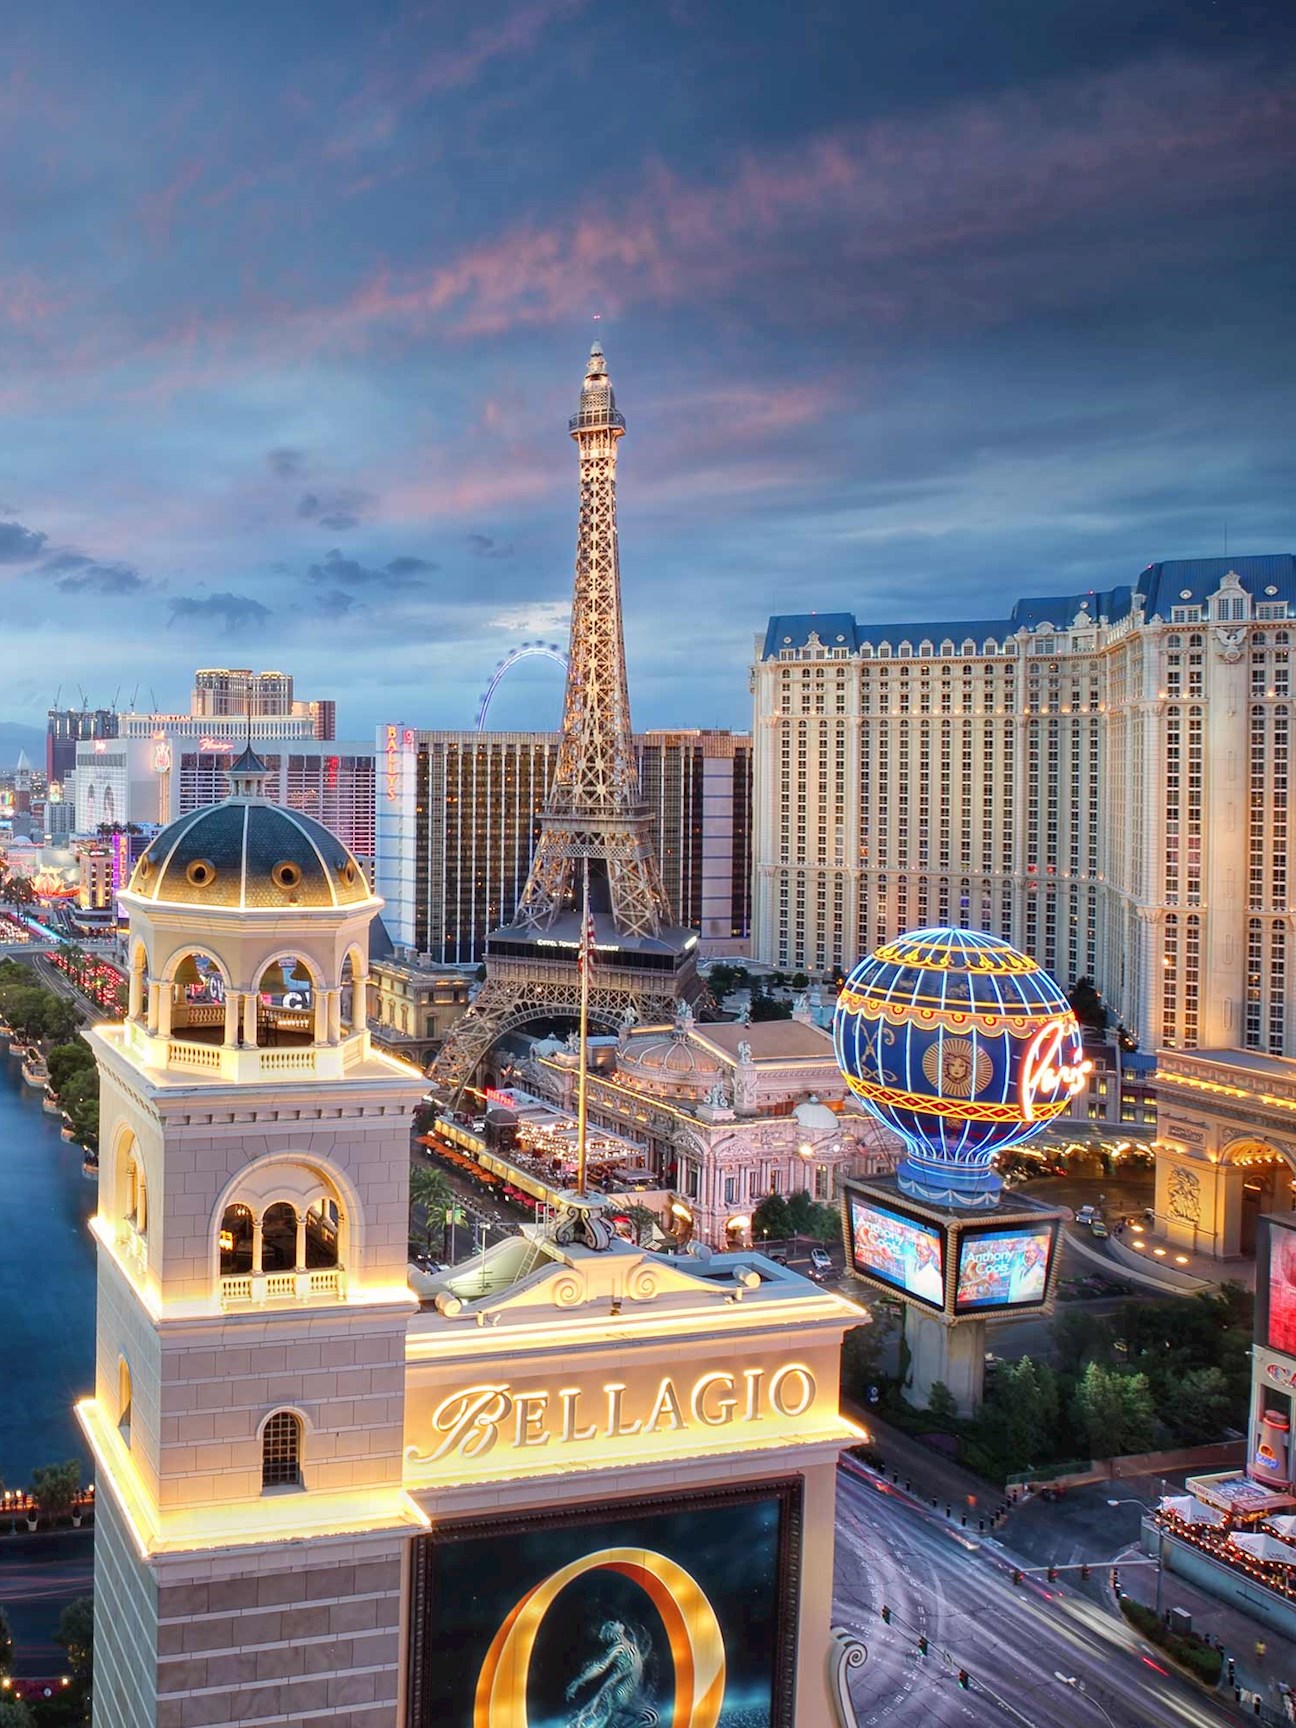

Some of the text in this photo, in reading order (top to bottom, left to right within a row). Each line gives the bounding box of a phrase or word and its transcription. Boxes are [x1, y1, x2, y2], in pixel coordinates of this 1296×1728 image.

[1022, 1021, 1093, 1121] Paris
[966, 1250, 1014, 1266] Anthony
[975, 1262, 1010, 1274] Cools
